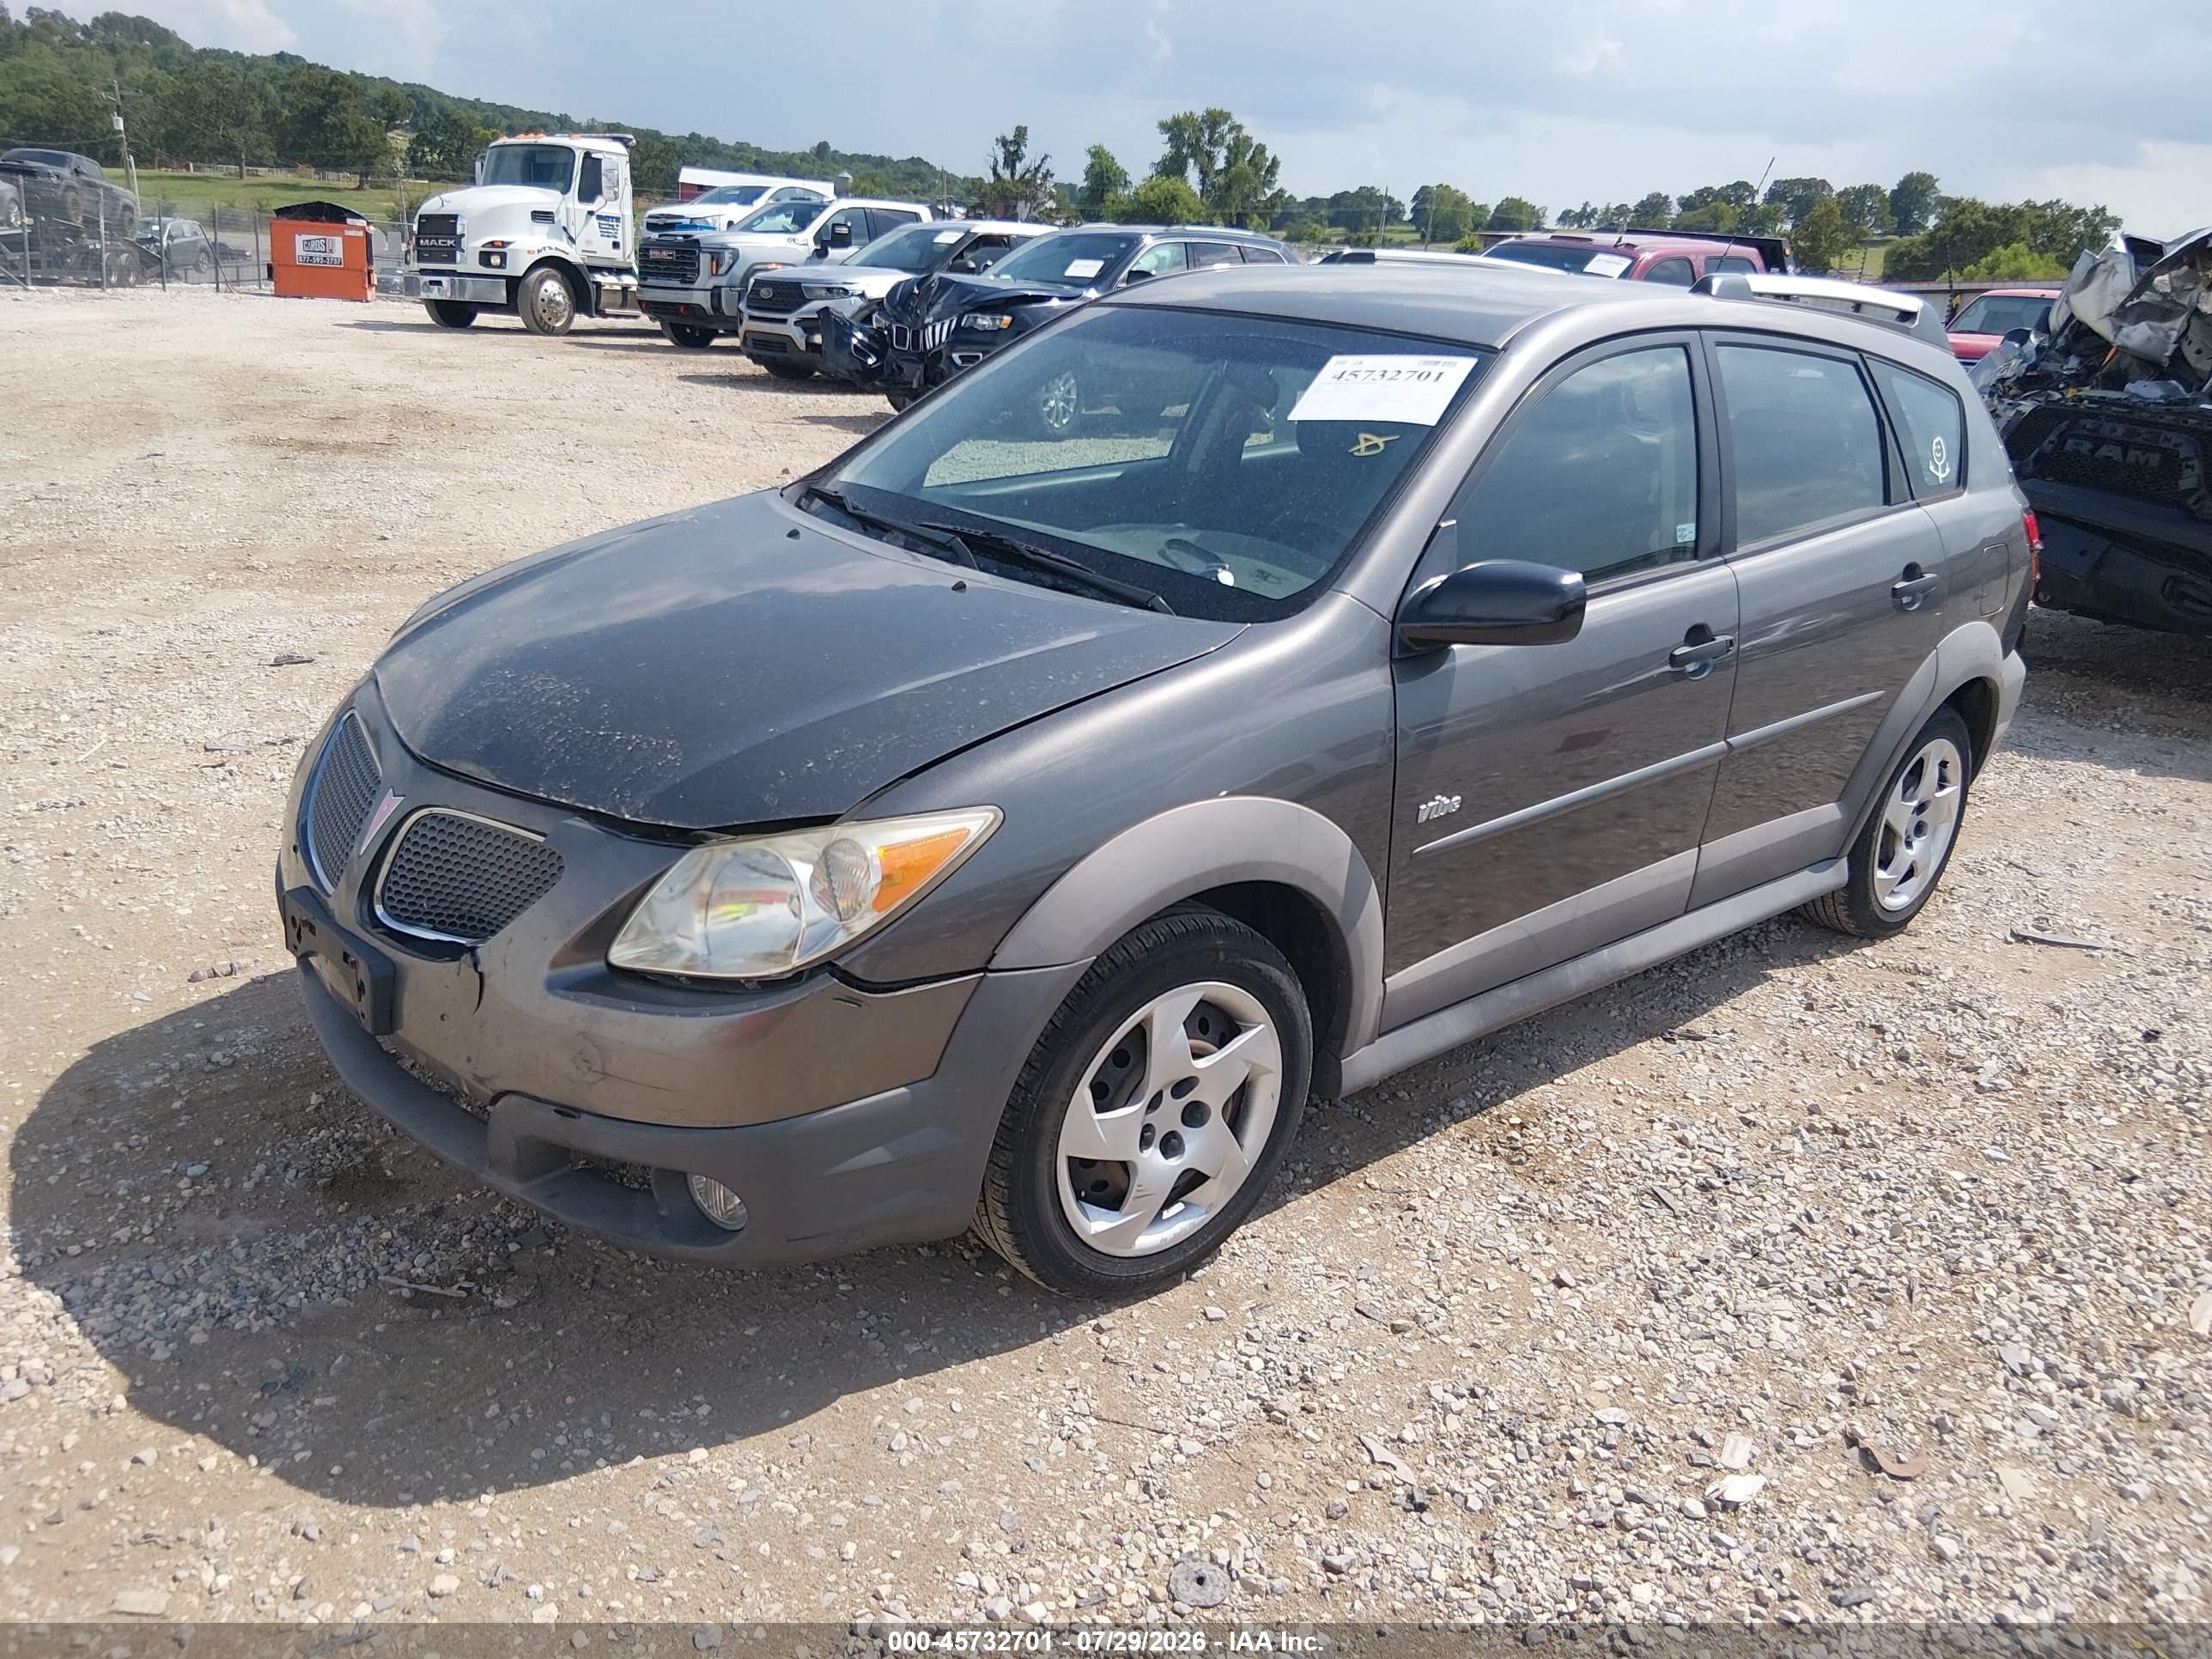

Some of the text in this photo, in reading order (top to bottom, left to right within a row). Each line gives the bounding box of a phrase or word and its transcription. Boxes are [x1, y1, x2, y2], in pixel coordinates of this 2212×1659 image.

[303, 239, 325, 252] CARDS
[649, 250, 674, 260] GMC
[1332, 369, 1444, 383] 45732701
